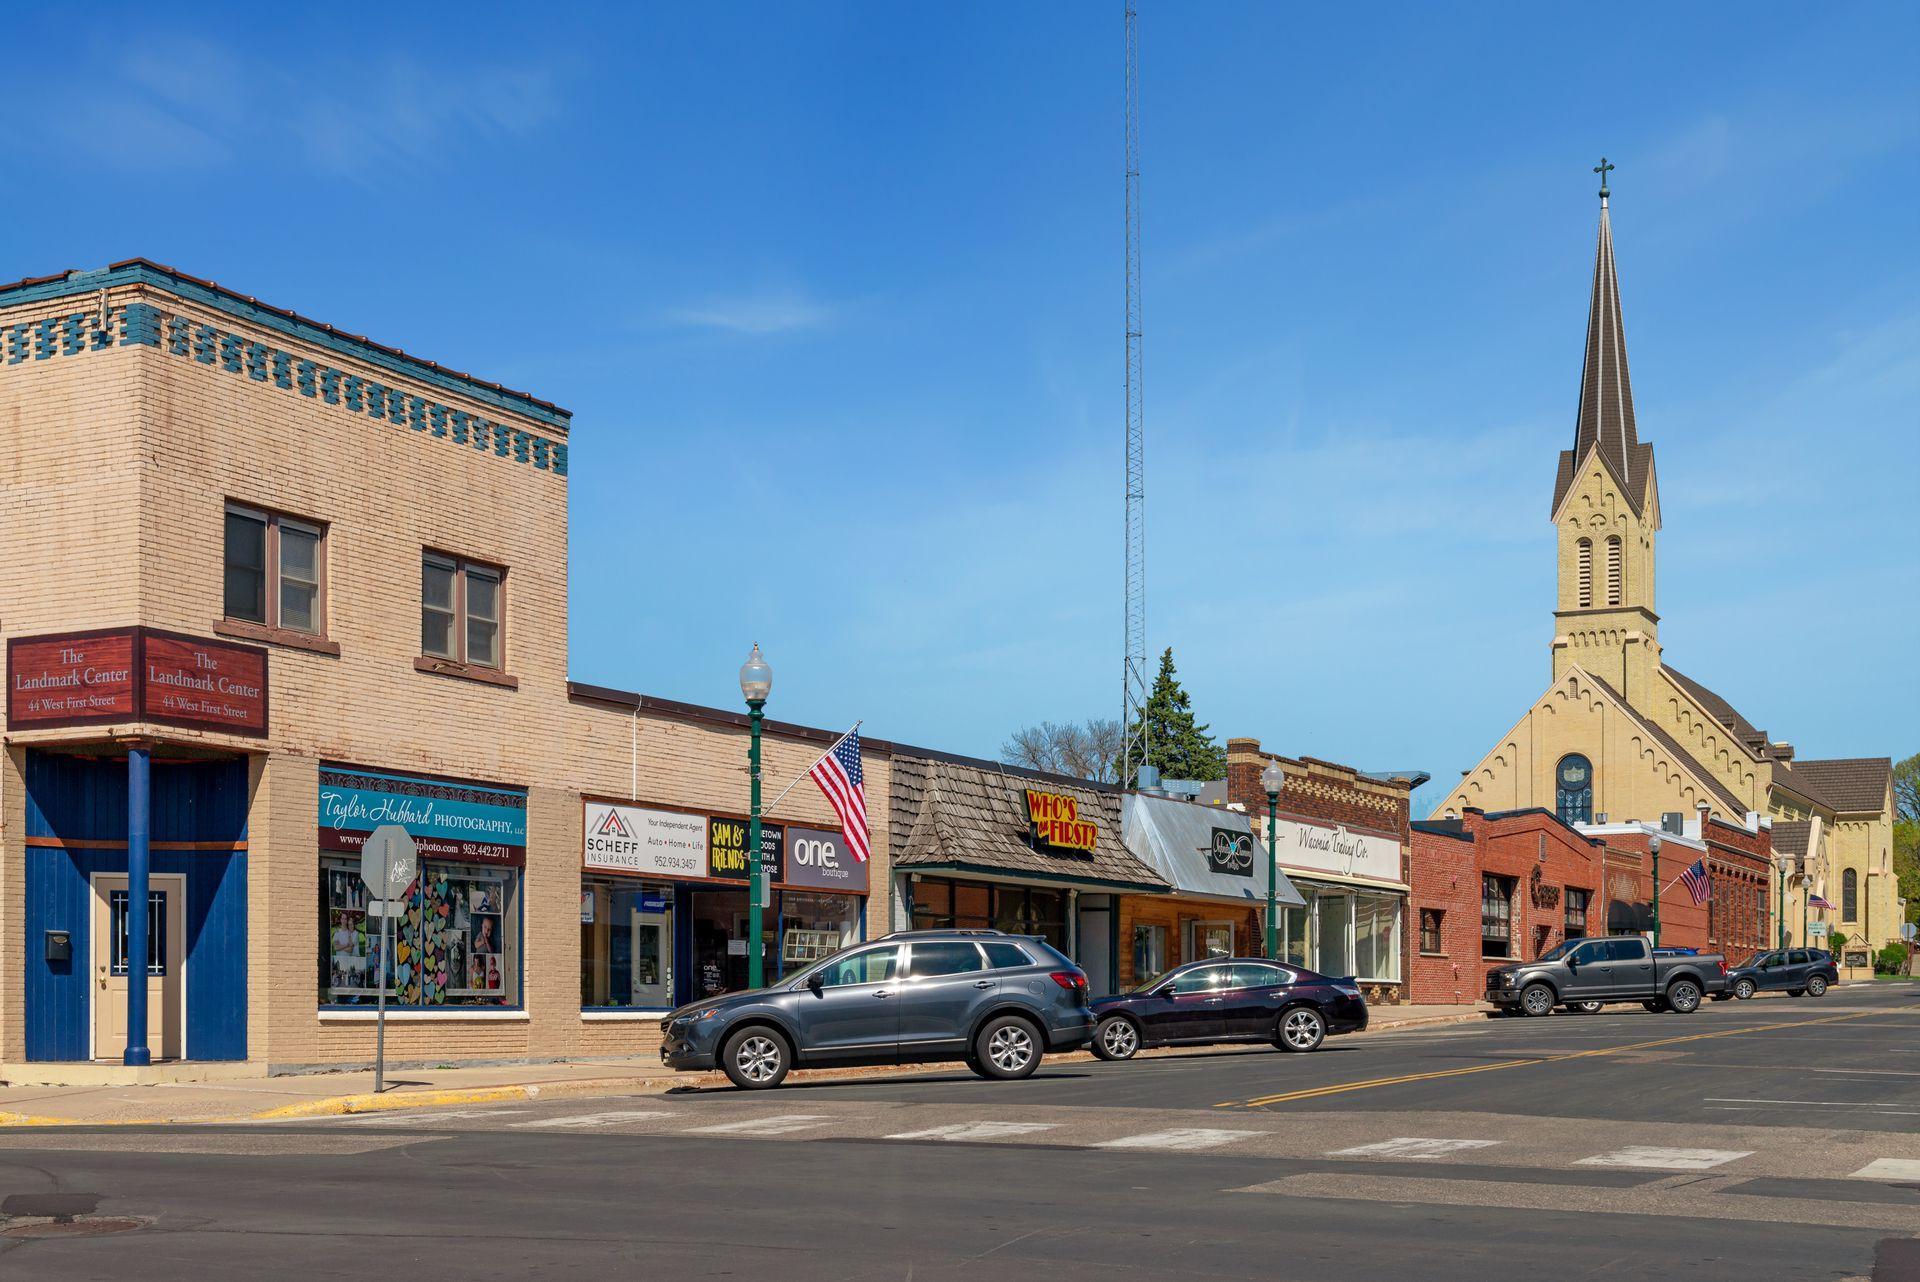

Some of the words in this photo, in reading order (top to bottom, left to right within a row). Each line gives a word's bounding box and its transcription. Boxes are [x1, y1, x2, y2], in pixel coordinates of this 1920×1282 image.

[60, 649, 84, 664] The
[194, 652, 218, 670] The
[16, 669, 81, 690] Landmark
[84, 667, 128, 685] Center
[150, 666, 215, 692] Landmark
[218, 678, 260, 699] Center
[28, 700, 40, 712] 44
[42, 699, 64, 711] West
[67, 697, 88, 709] First
[89, 695, 116, 708] Street
[162, 695, 175, 708] 44
[176, 697, 199, 712] West
[201, 701, 222, 715] First
[223, 704, 249, 719] Street
[321, 791, 369, 830] Taylor
[369, 798, 432, 824] Hubbard
[434, 814, 513, 834] PHOTOGRAPHY,
[1028, 792, 1076, 821] WHO'S
[648, 818, 659, 826] Your
[659, 819, 688, 831] Independent
[689, 823, 703, 833] Agent
[712, 822, 732, 847] SAM
[1038, 820, 1049, 835] on
[1049, 820, 1097, 847] FIRST?
[462, 843, 510, 858] 952.442.2711
[587, 838, 639, 855] SCHEFF
[647, 837, 663, 846] Auto
[668, 839, 686, 849] Home
[692, 841, 704, 851] Life
[1299, 827, 1331, 852] Waconia
[1331, 826, 1355, 875] Trading
[587, 853, 639, 866] INSURANCE
[712, 847, 745, 872] FRIENDS
[822, 868, 849, 879] boutique
